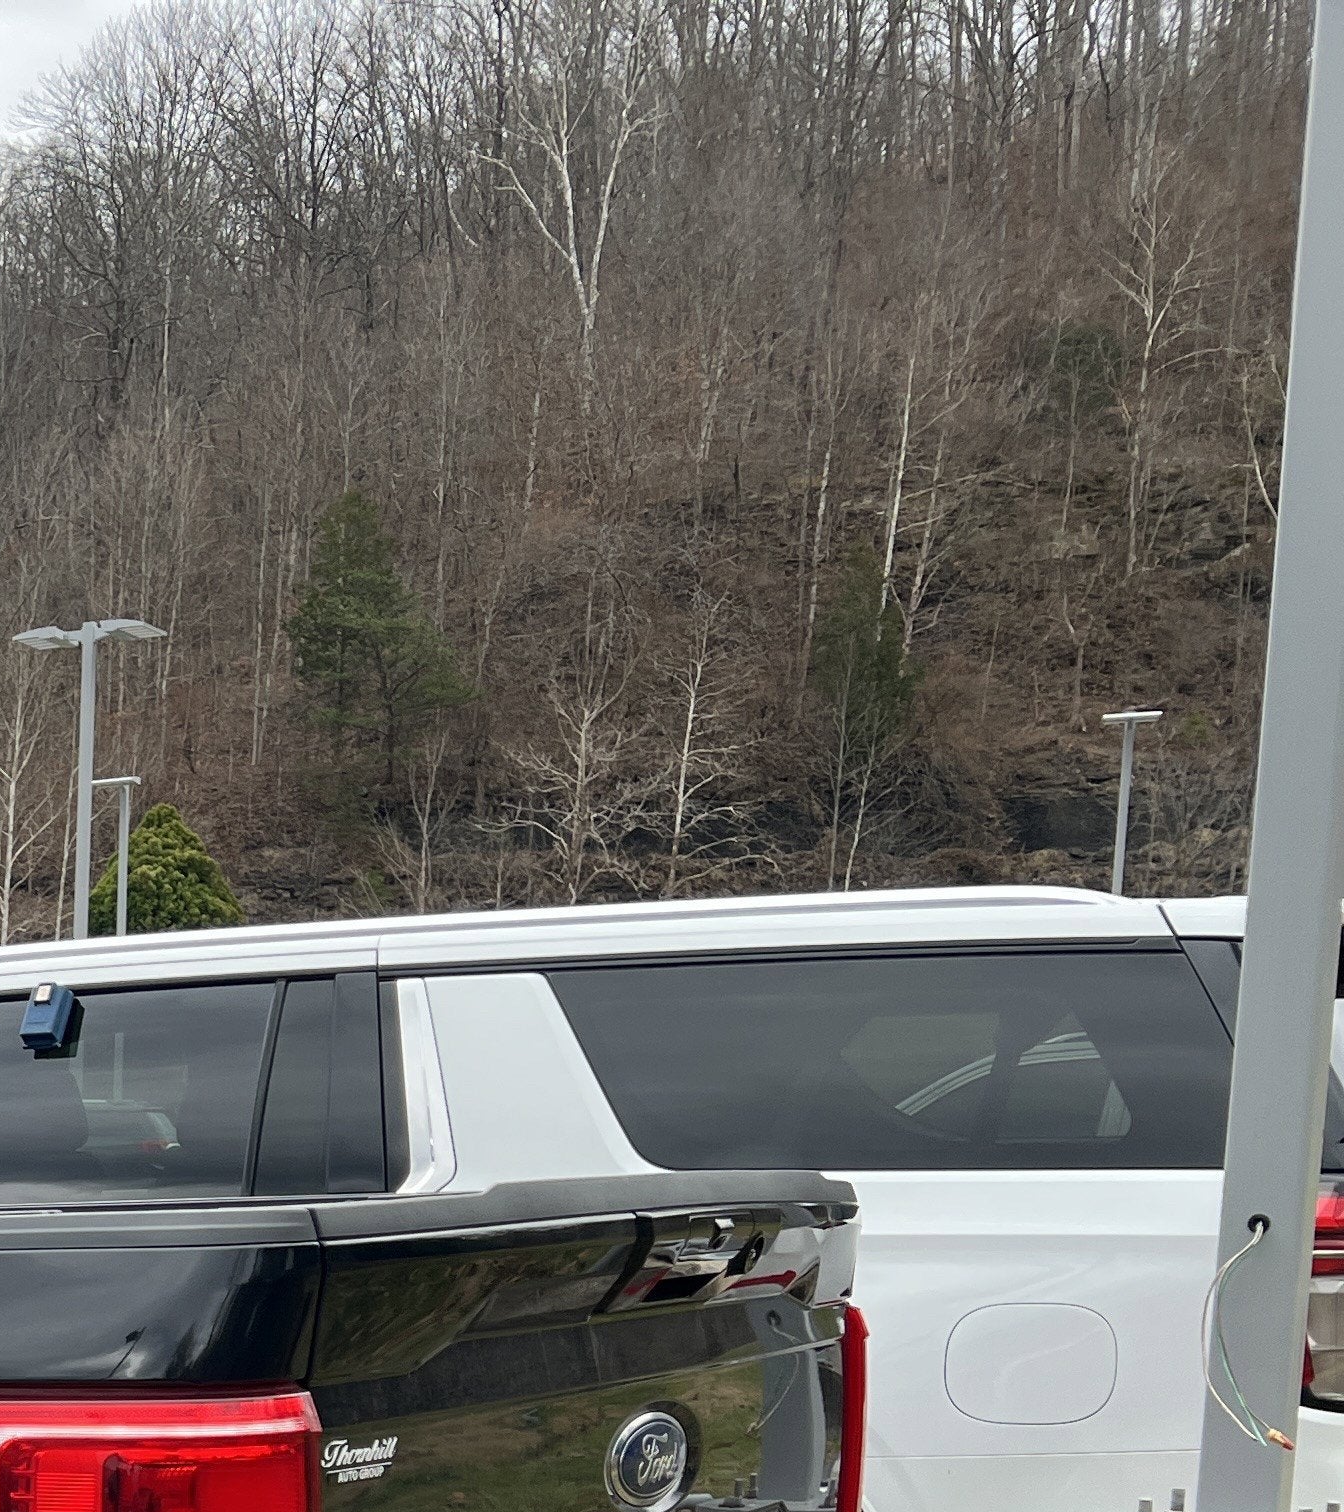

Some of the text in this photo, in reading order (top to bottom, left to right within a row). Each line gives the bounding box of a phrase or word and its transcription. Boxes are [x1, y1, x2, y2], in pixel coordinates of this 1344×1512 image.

[320, 1436, 399, 1468] Thornhill
[637, 1432, 679, 1487] Ford
[337, 1465, 385, 1484] AUTO GROUP
